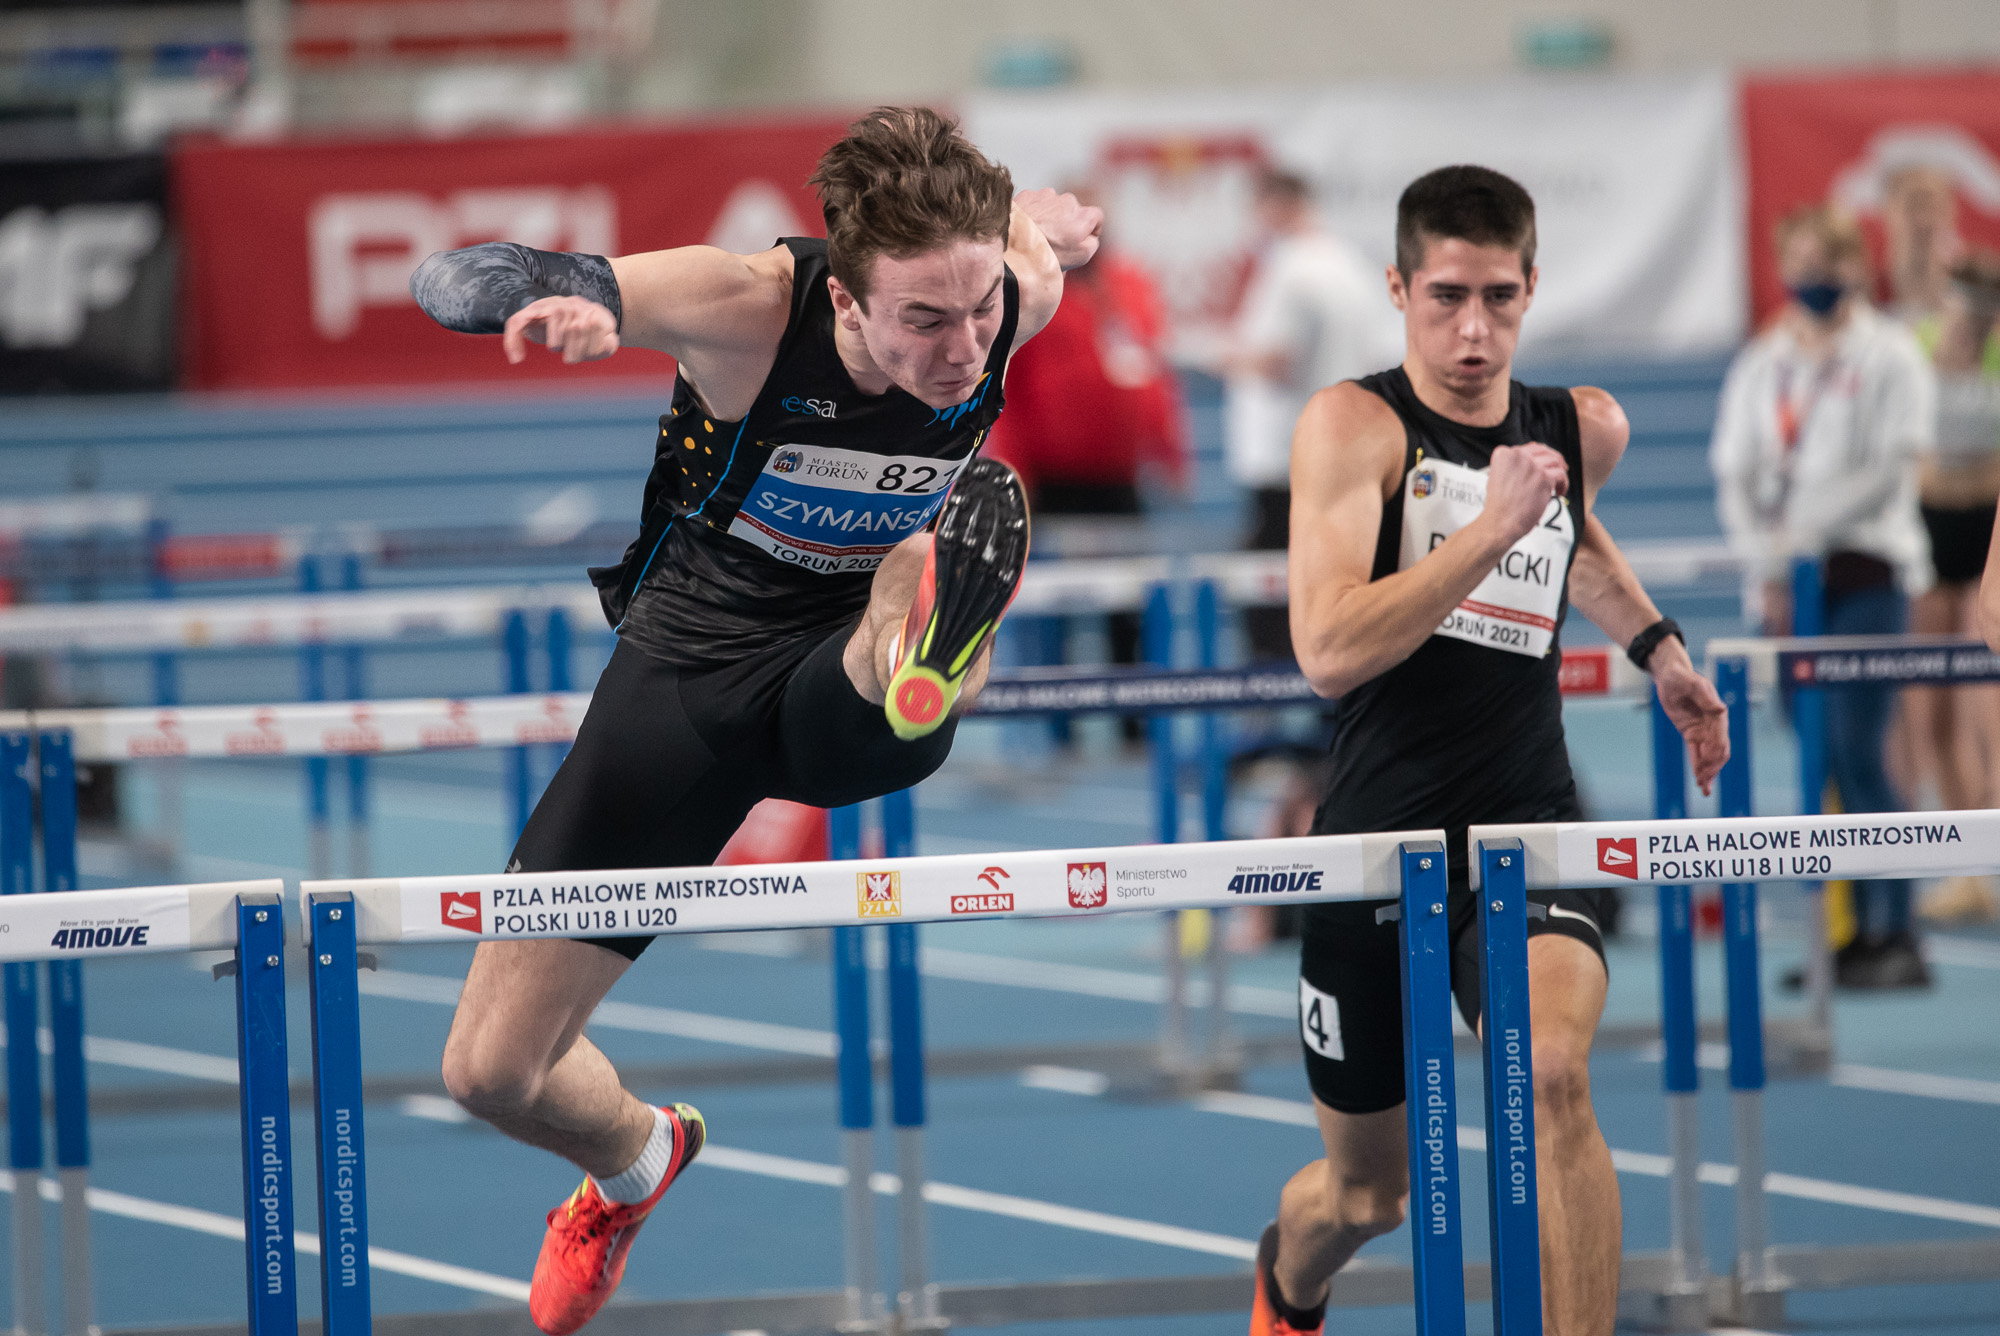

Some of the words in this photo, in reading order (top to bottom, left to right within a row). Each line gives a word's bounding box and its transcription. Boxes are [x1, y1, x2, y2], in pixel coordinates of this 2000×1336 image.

[806, 463, 869, 482] TORUŃ
[811, 457, 858, 469] MIASTO
[876, 463, 961, 494] 821
[756, 491, 945, 532] SZYMAŃSKI
[773, 543, 842, 572] TORUŃ
[845, 557, 884, 569] 202
[1442, 614, 1485, 638] ORUŃ
[1490, 625, 1530, 648] 2021
[1648, 834, 1700, 854] PZLA
[1707, 830, 1801, 852] HALOWE
[1809, 824, 1962, 849] MISTRZOSTWA
[1116, 868, 1188, 881] Ministerstwo
[1236, 865, 1254, 873] Now
[1271, 864, 1290, 873] your
[1292, 863, 1314, 871] Move
[1650, 860, 1723, 880] POLSKI
[1732, 858, 1771, 877] U18
[1779, 857, 1785, 875] I
[1793, 855, 1832, 874] U20
[493, 887, 545, 907] PZLA
[552, 883, 647, 905] HALOWE
[655, 875, 808, 901] MISTRZOSTWA
[1116, 886, 1155, 899] Sportu
[1226, 870, 1324, 894] 4MOVE
[860, 901, 899, 916] PZLA
[953, 895, 1011, 912] ORLEN
[95, 919, 115, 928] your
[494, 912, 568, 933] POLSKI
[577, 910, 617, 930] U18
[624, 910, 630, 928] I
[638, 908, 677, 927] U20
[51, 925, 150, 950] 4MOVE
[1307, 997, 1329, 1050] 4
[1504, 1028, 1527, 1205] nordicsport.com
[1424, 1058, 1448, 1235] nordicsport.com
[260, 1116, 283, 1295] nordicsport.com
[334, 1108, 357, 1287] nordicsport.com
